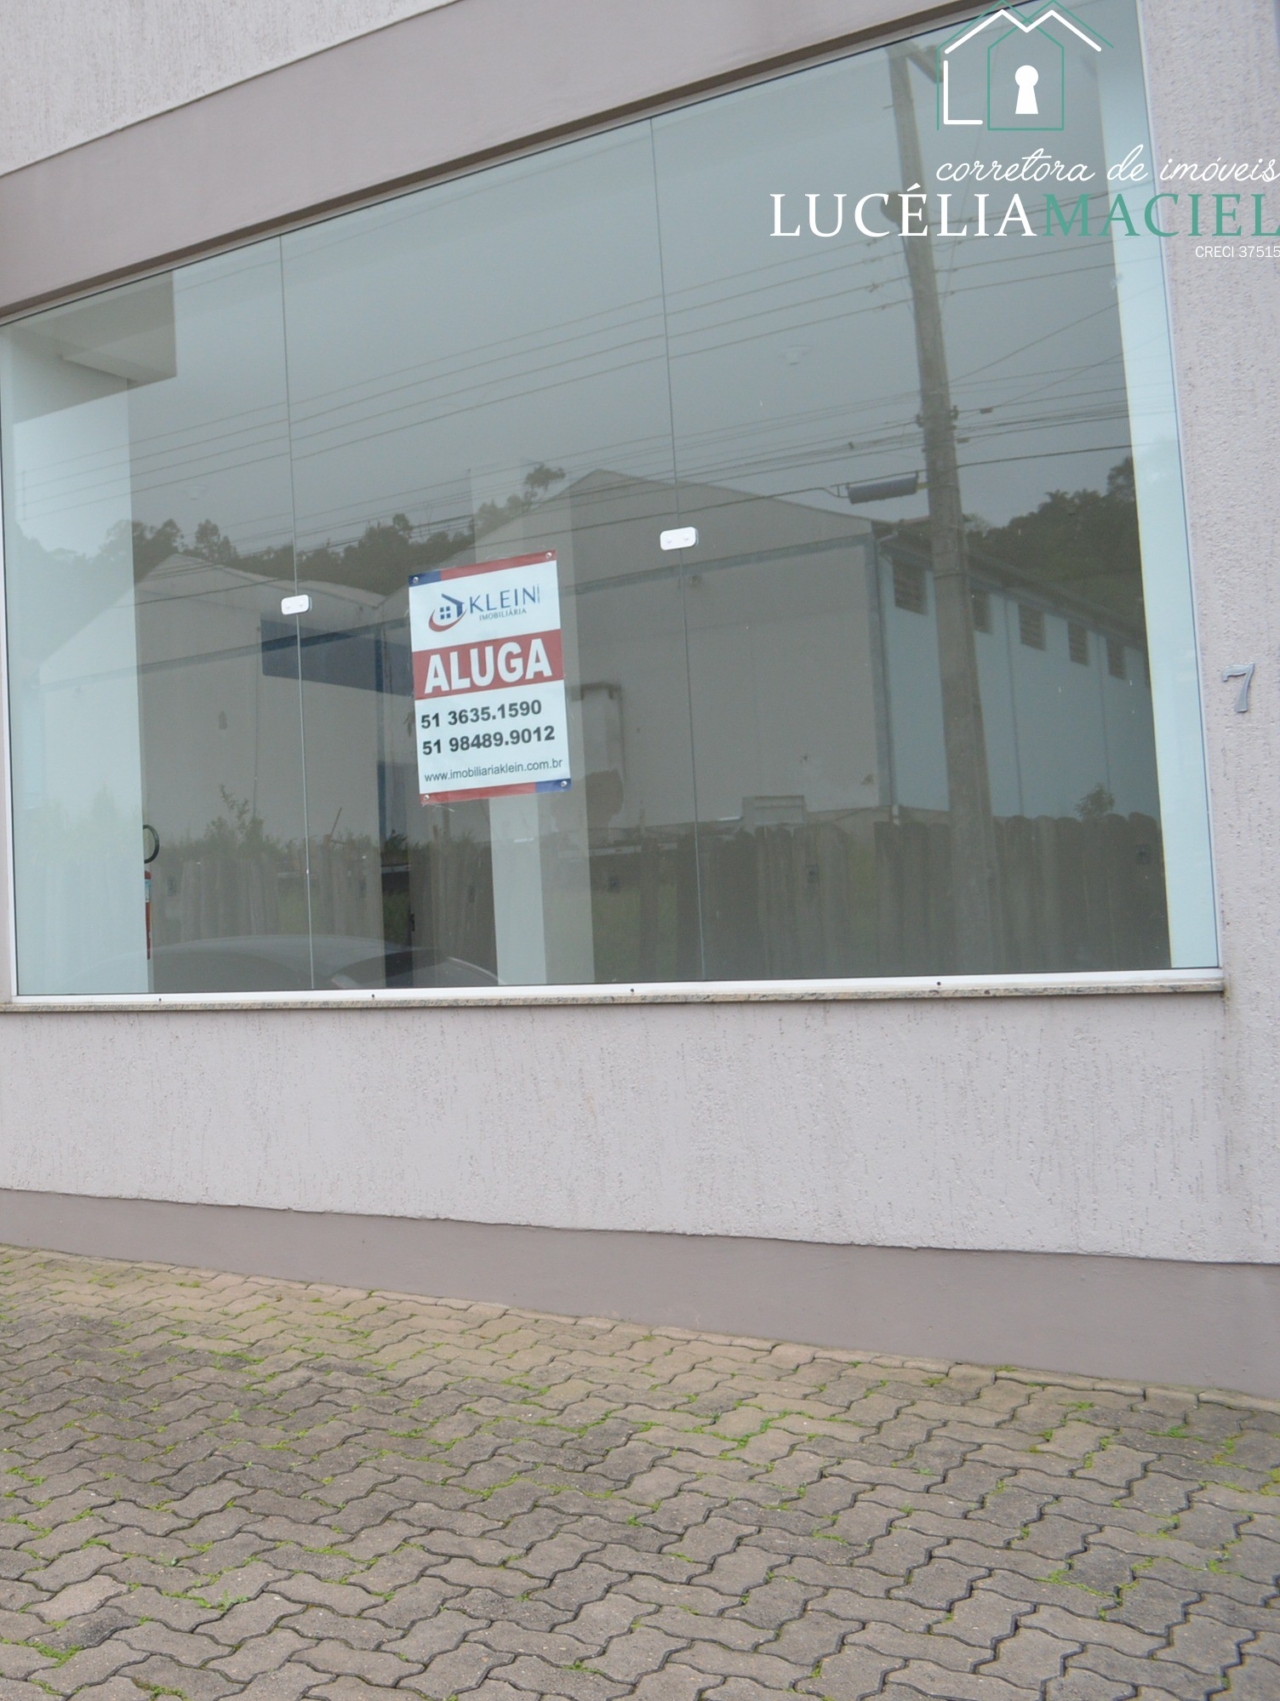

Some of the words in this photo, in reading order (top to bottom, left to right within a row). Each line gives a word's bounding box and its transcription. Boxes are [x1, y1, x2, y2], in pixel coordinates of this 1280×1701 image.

[469, 585, 536, 614] KLEIN
[479, 607, 527, 621] IMOBILIÁRIA
[424, 638, 553, 694] ALUGA
[1222, 661, 1255, 713] 7
[421, 713, 440, 729] 51
[448, 699, 542, 726] 3635.1590
[422, 739, 442, 756] 51
[449, 725, 555, 753] 98489.9012
[424, 758, 563, 782] www.imobiliariaklein.com.br
